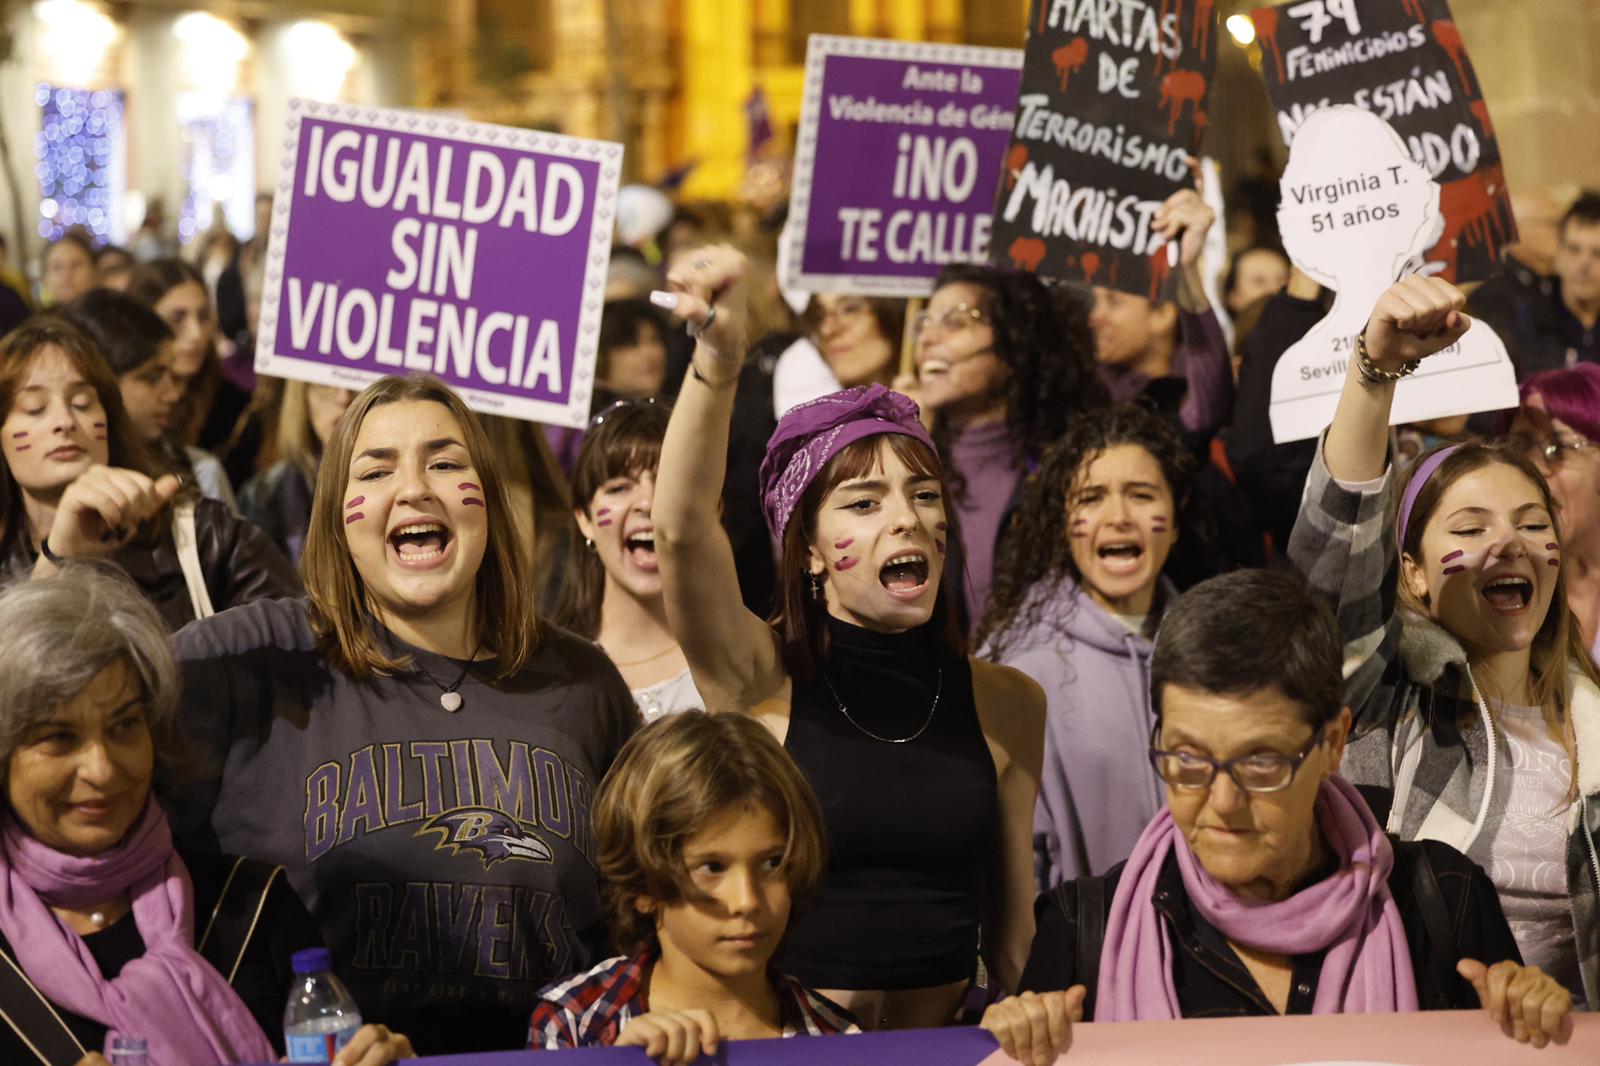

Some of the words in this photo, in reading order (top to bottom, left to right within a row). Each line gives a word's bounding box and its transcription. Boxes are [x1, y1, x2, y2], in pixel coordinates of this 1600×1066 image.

[1286, 0, 1361, 44] 79
[903, 65, 959, 91] Ante
[961, 68, 983, 95] la
[1098, 51, 1141, 98] DE
[829, 95, 934, 127] Violencia
[937, 103, 967, 128] de
[970, 104, 1016, 131] Gén
[304, 126, 585, 236] IGUALDAD
[1290, 173, 1381, 205] Virginia
[1387, 165, 1408, 187] T.
[838, 207, 883, 262] TE
[1311, 211, 1335, 233] 51
[1343, 202, 1400, 228] años
[386, 218, 478, 299] SIN
[288, 277, 562, 394] VIOLENCIA
[1300, 361, 1349, 381] Sevill
[304, 739, 597, 870] BALTIMOR
[352, 881, 575, 981] RAVENS
